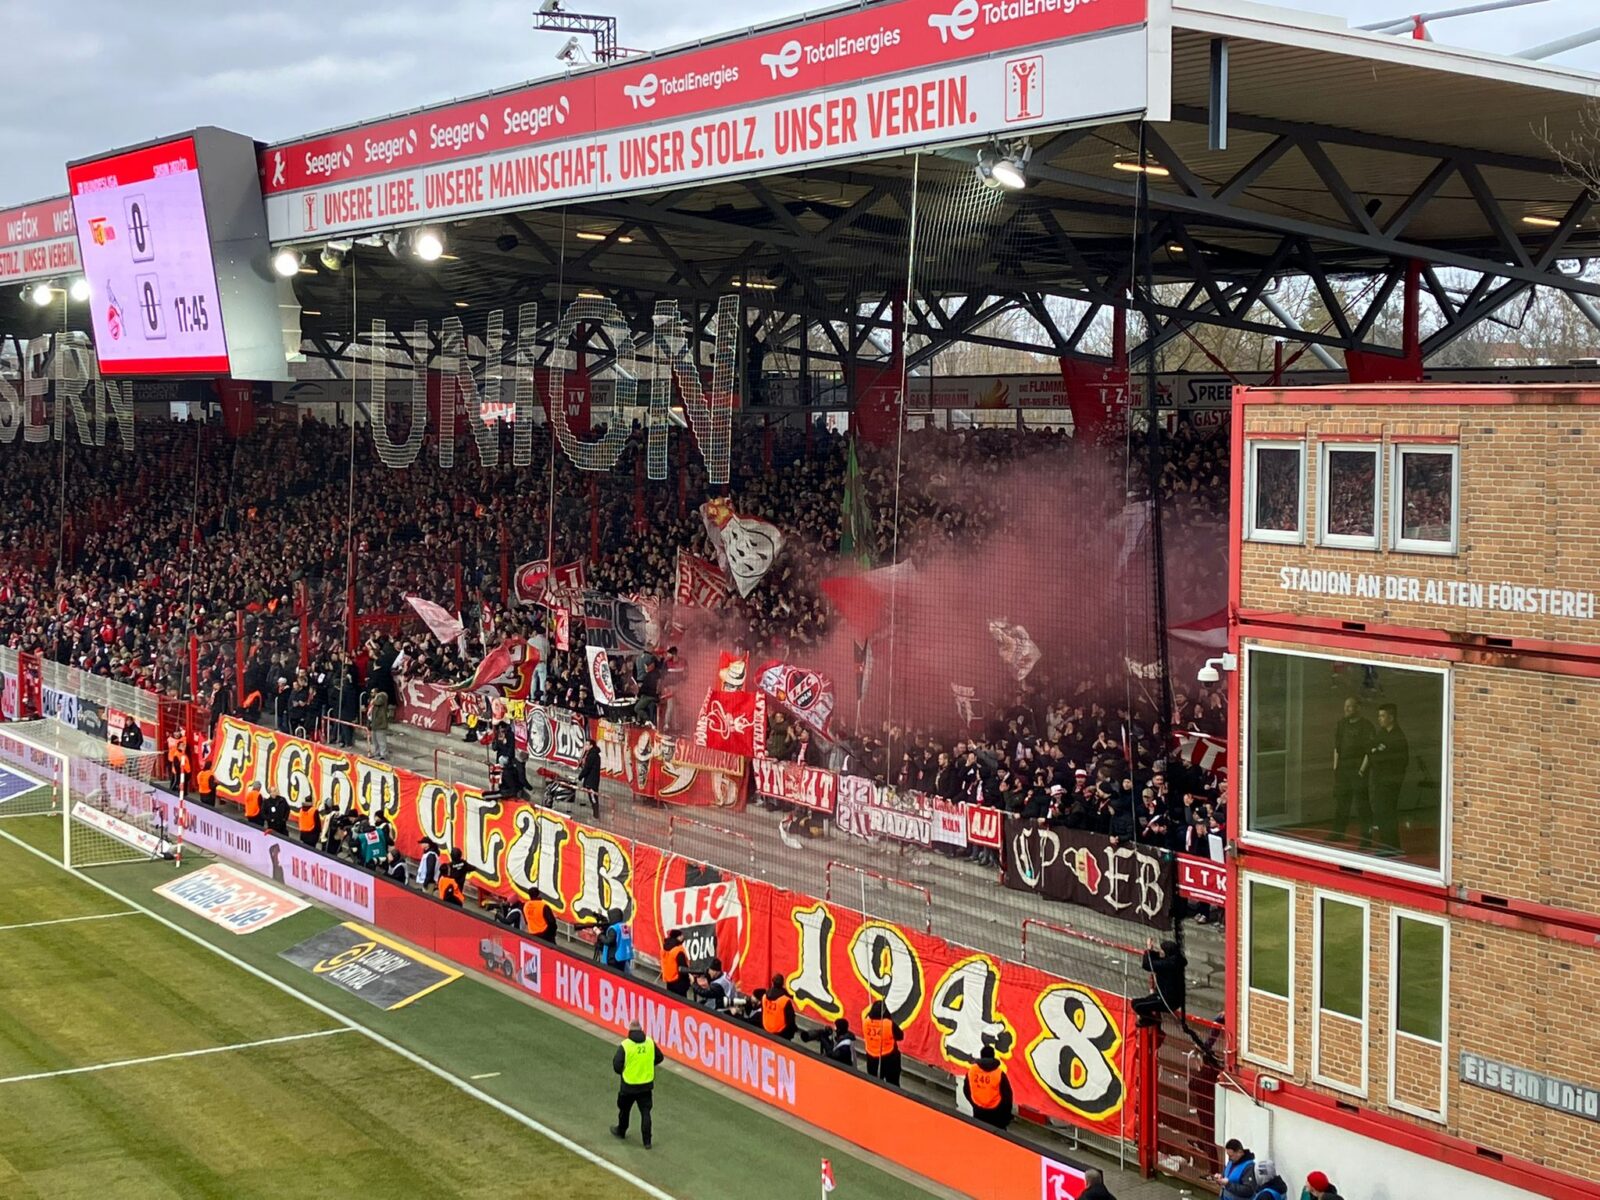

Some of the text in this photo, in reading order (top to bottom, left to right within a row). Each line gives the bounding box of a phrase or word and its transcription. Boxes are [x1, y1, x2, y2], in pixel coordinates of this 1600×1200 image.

[803, 28, 901, 65] TotalEnergies
[660, 64, 739, 96] TotalEnergies
[430, 122, 476, 150] Seeger
[504, 103, 554, 135] Seeger
[305, 150, 343, 176] Seeger
[324, 75, 977, 226] UNSERE LIEBE. UNSERE MANNSCHAFT. UNSER STOLZ. UNSER VEREIN.
[364, 137, 405, 164] Seeger
[7, 211, 39, 242] wefox
[131, 202, 146, 253] 0
[143, 281, 158, 331] 0
[174, 295, 209, 332] 17:45
[371, 295, 740, 484] UNION
[1280, 566, 1595, 619] STADION AN DER ALTEN FÖRSTEREI
[674, 884, 726, 925] 1.FC
[683, 931, 715, 961] KÖLN
[785, 902, 1130, 1120] 1948
[555, 960, 796, 1105] HKL BAUMASCHINEN
